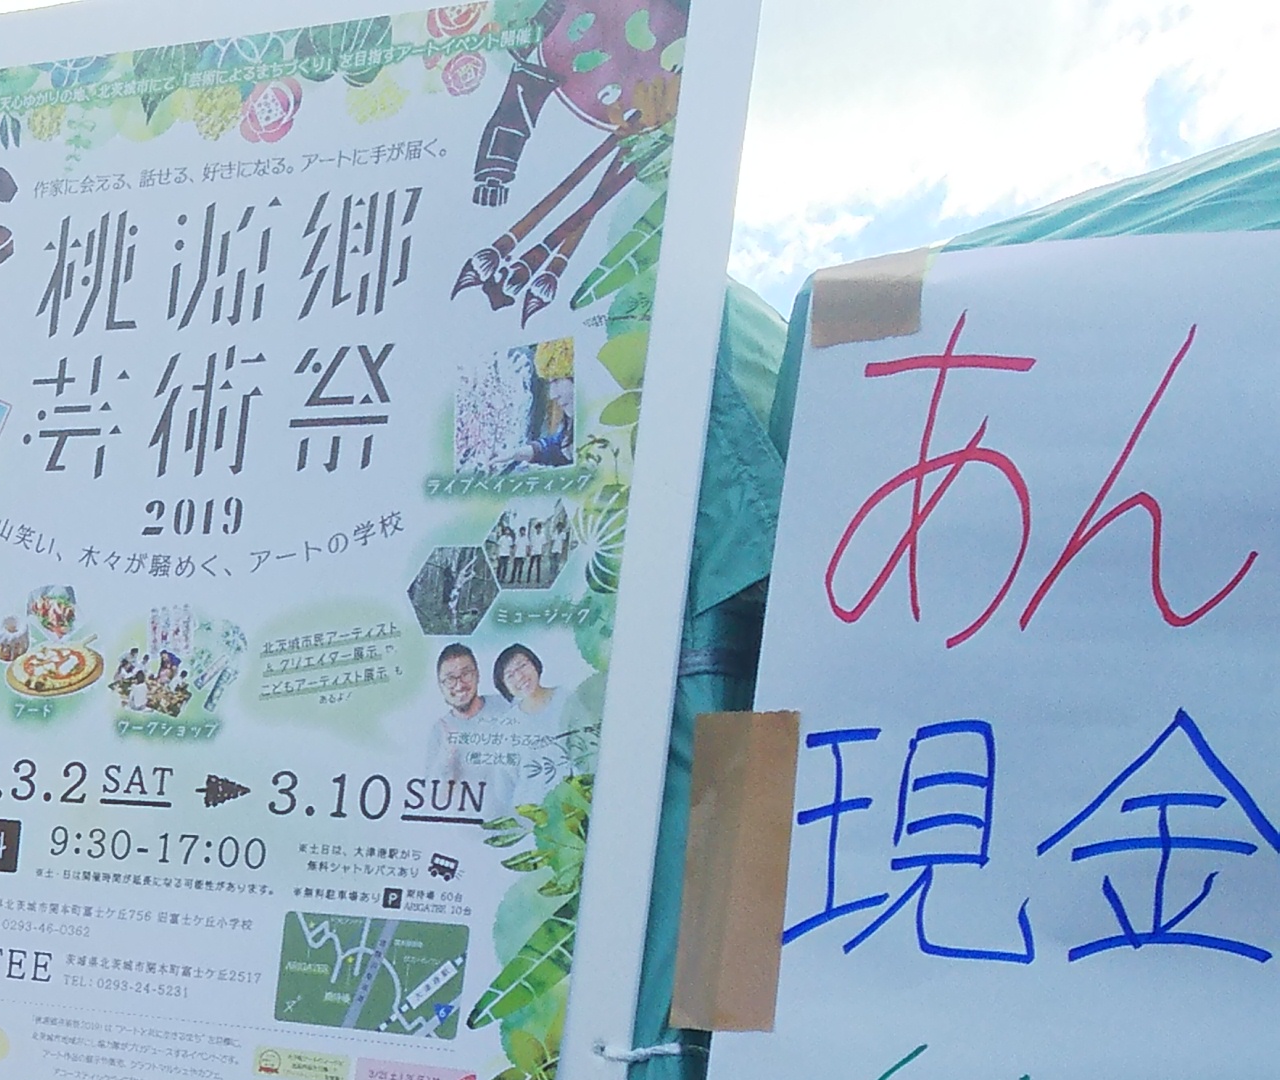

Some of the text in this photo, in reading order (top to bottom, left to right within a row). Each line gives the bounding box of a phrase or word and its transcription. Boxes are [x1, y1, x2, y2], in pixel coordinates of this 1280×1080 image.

[36, 187, 422, 338] 桃源郷
[23, 343, 395, 479] 芸術祭
[825, 309, 1258, 648] あん
[141, 497, 244, 536] 2019
[13, 703, 54, 719] フード
[117, 719, 219, 738] ワークショップ
[102, 765, 174, 797] SAT
[268, 771, 391, 820] 3.10
[403, 777, 487, 812] SUN
[50, 826, 267, 870] 9:30-17:00
[782, 707, 1280, 964] 現金
